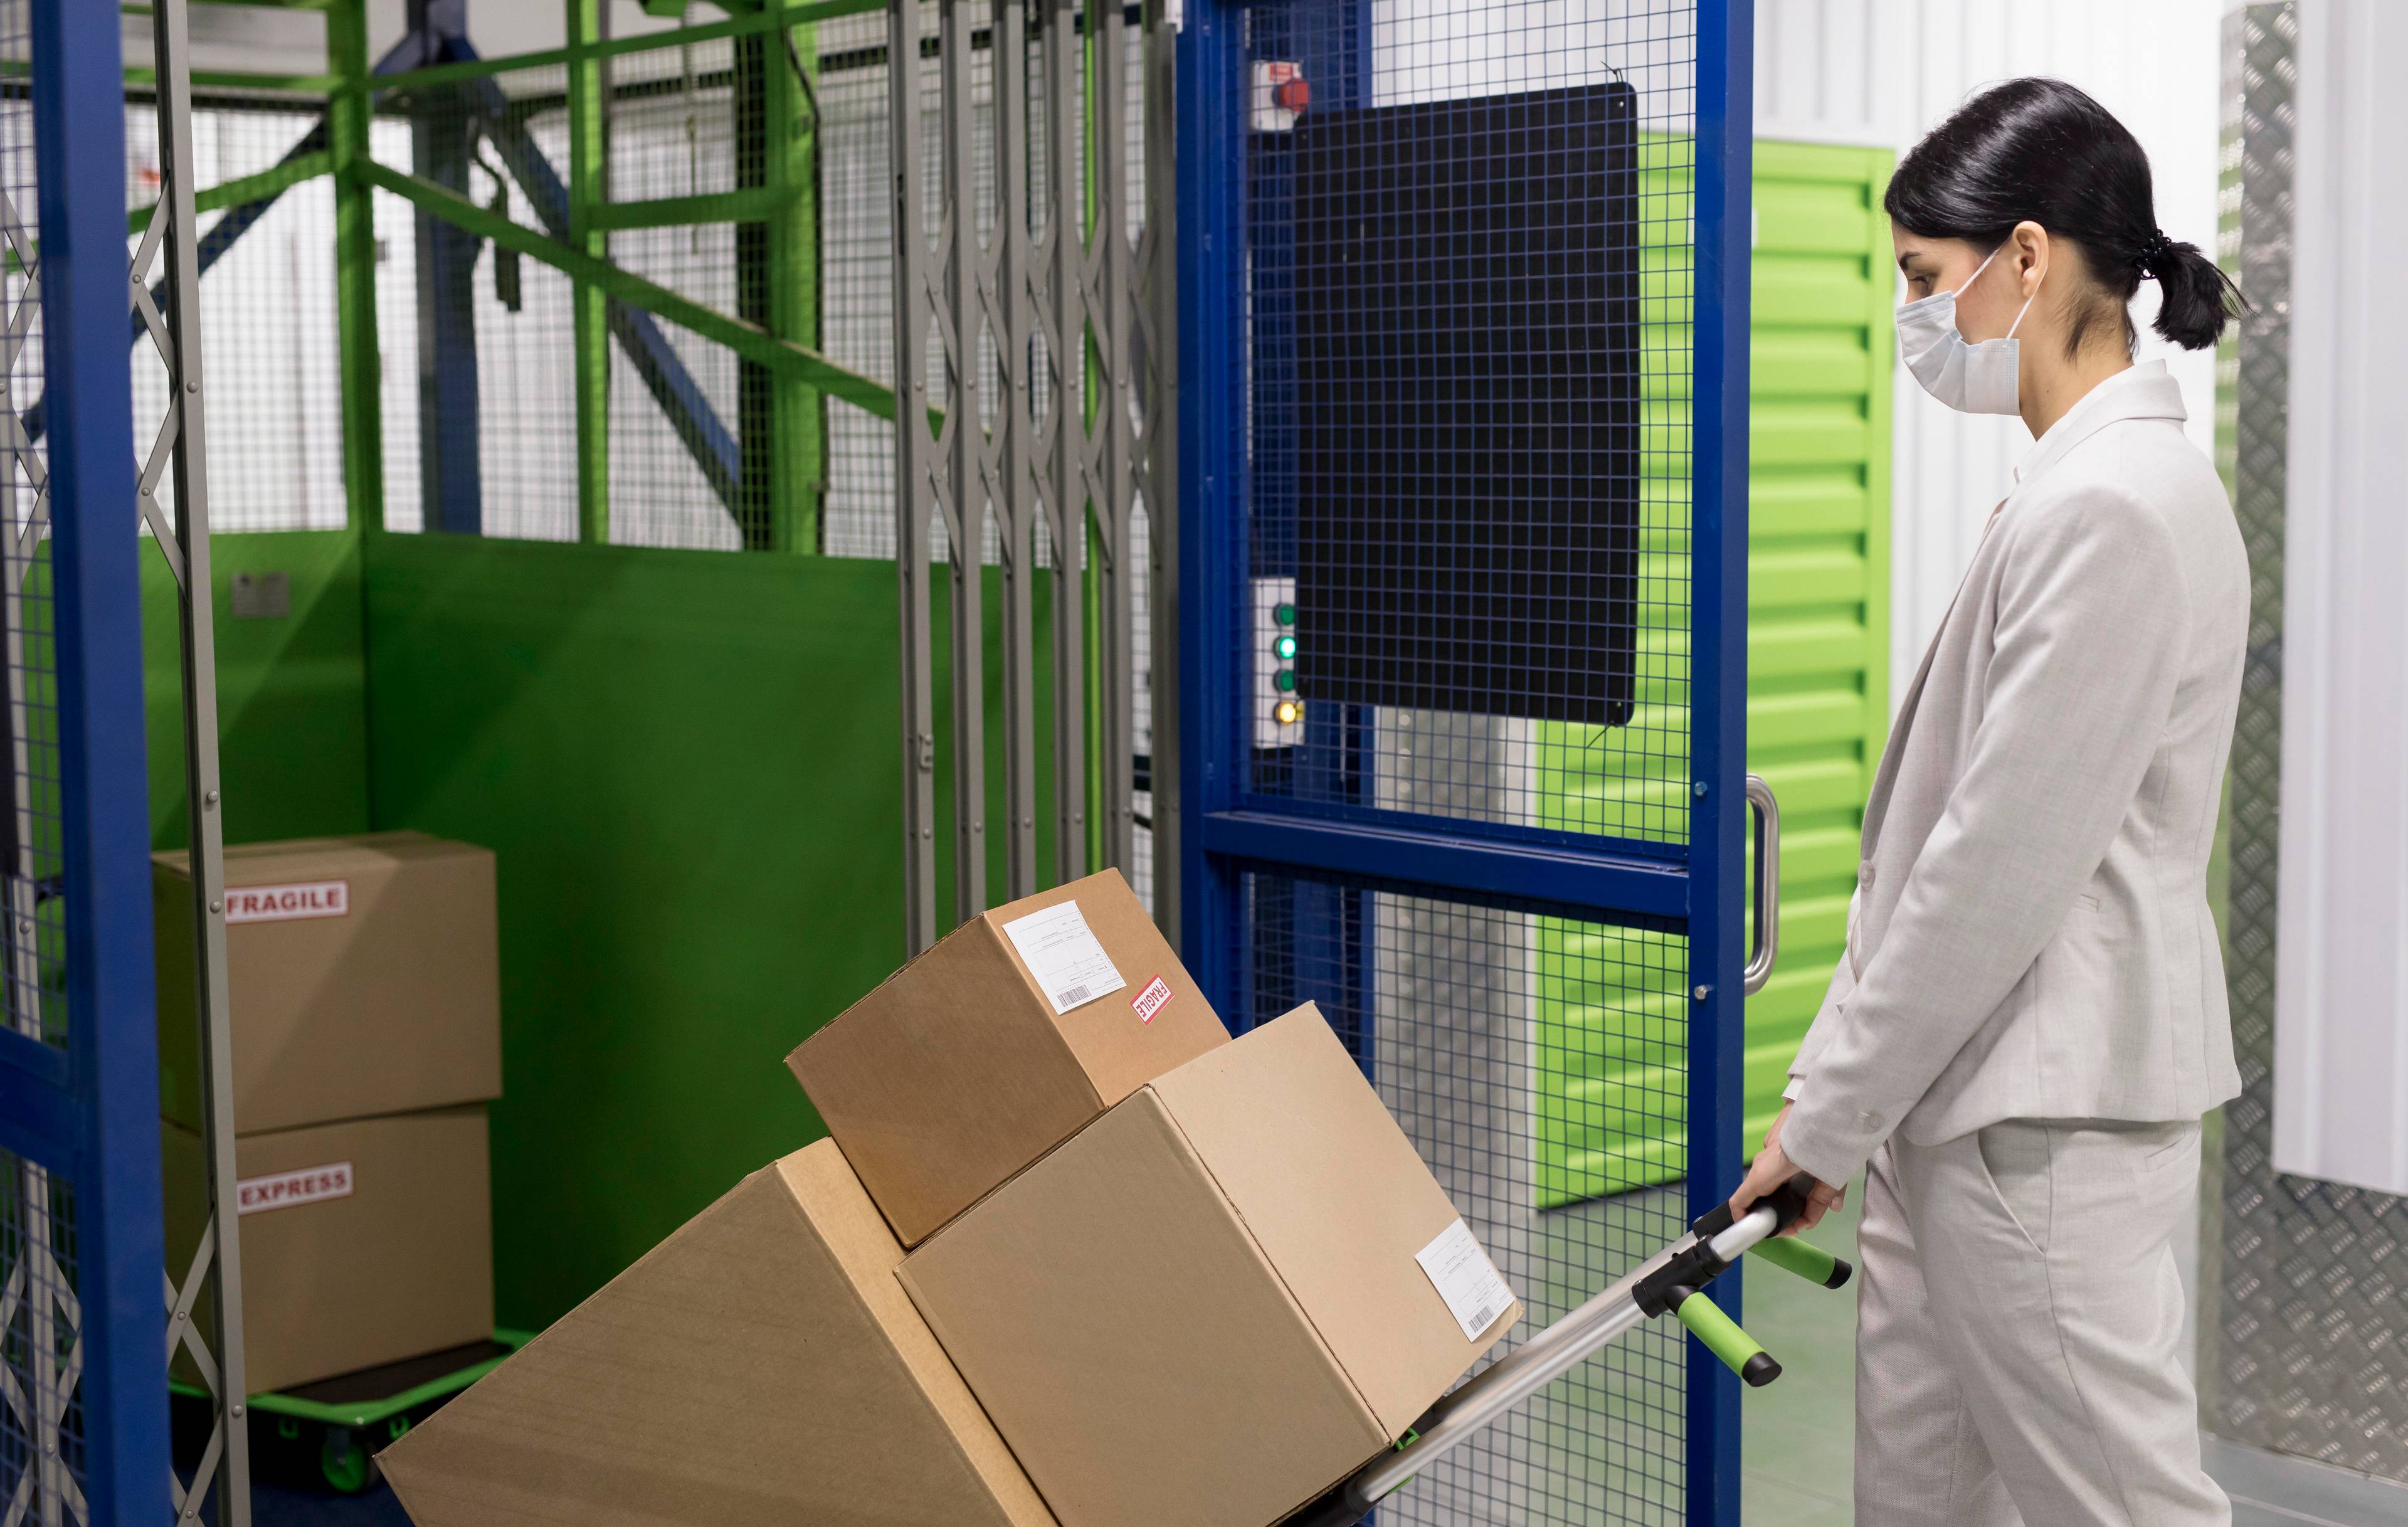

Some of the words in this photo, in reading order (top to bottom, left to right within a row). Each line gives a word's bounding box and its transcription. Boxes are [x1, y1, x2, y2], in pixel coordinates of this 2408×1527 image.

[226, 888, 341, 914] FRAGILE
[1136, 981, 1168, 1018] FRAGILE
[241, 1171, 346, 1205] EXPRESS
